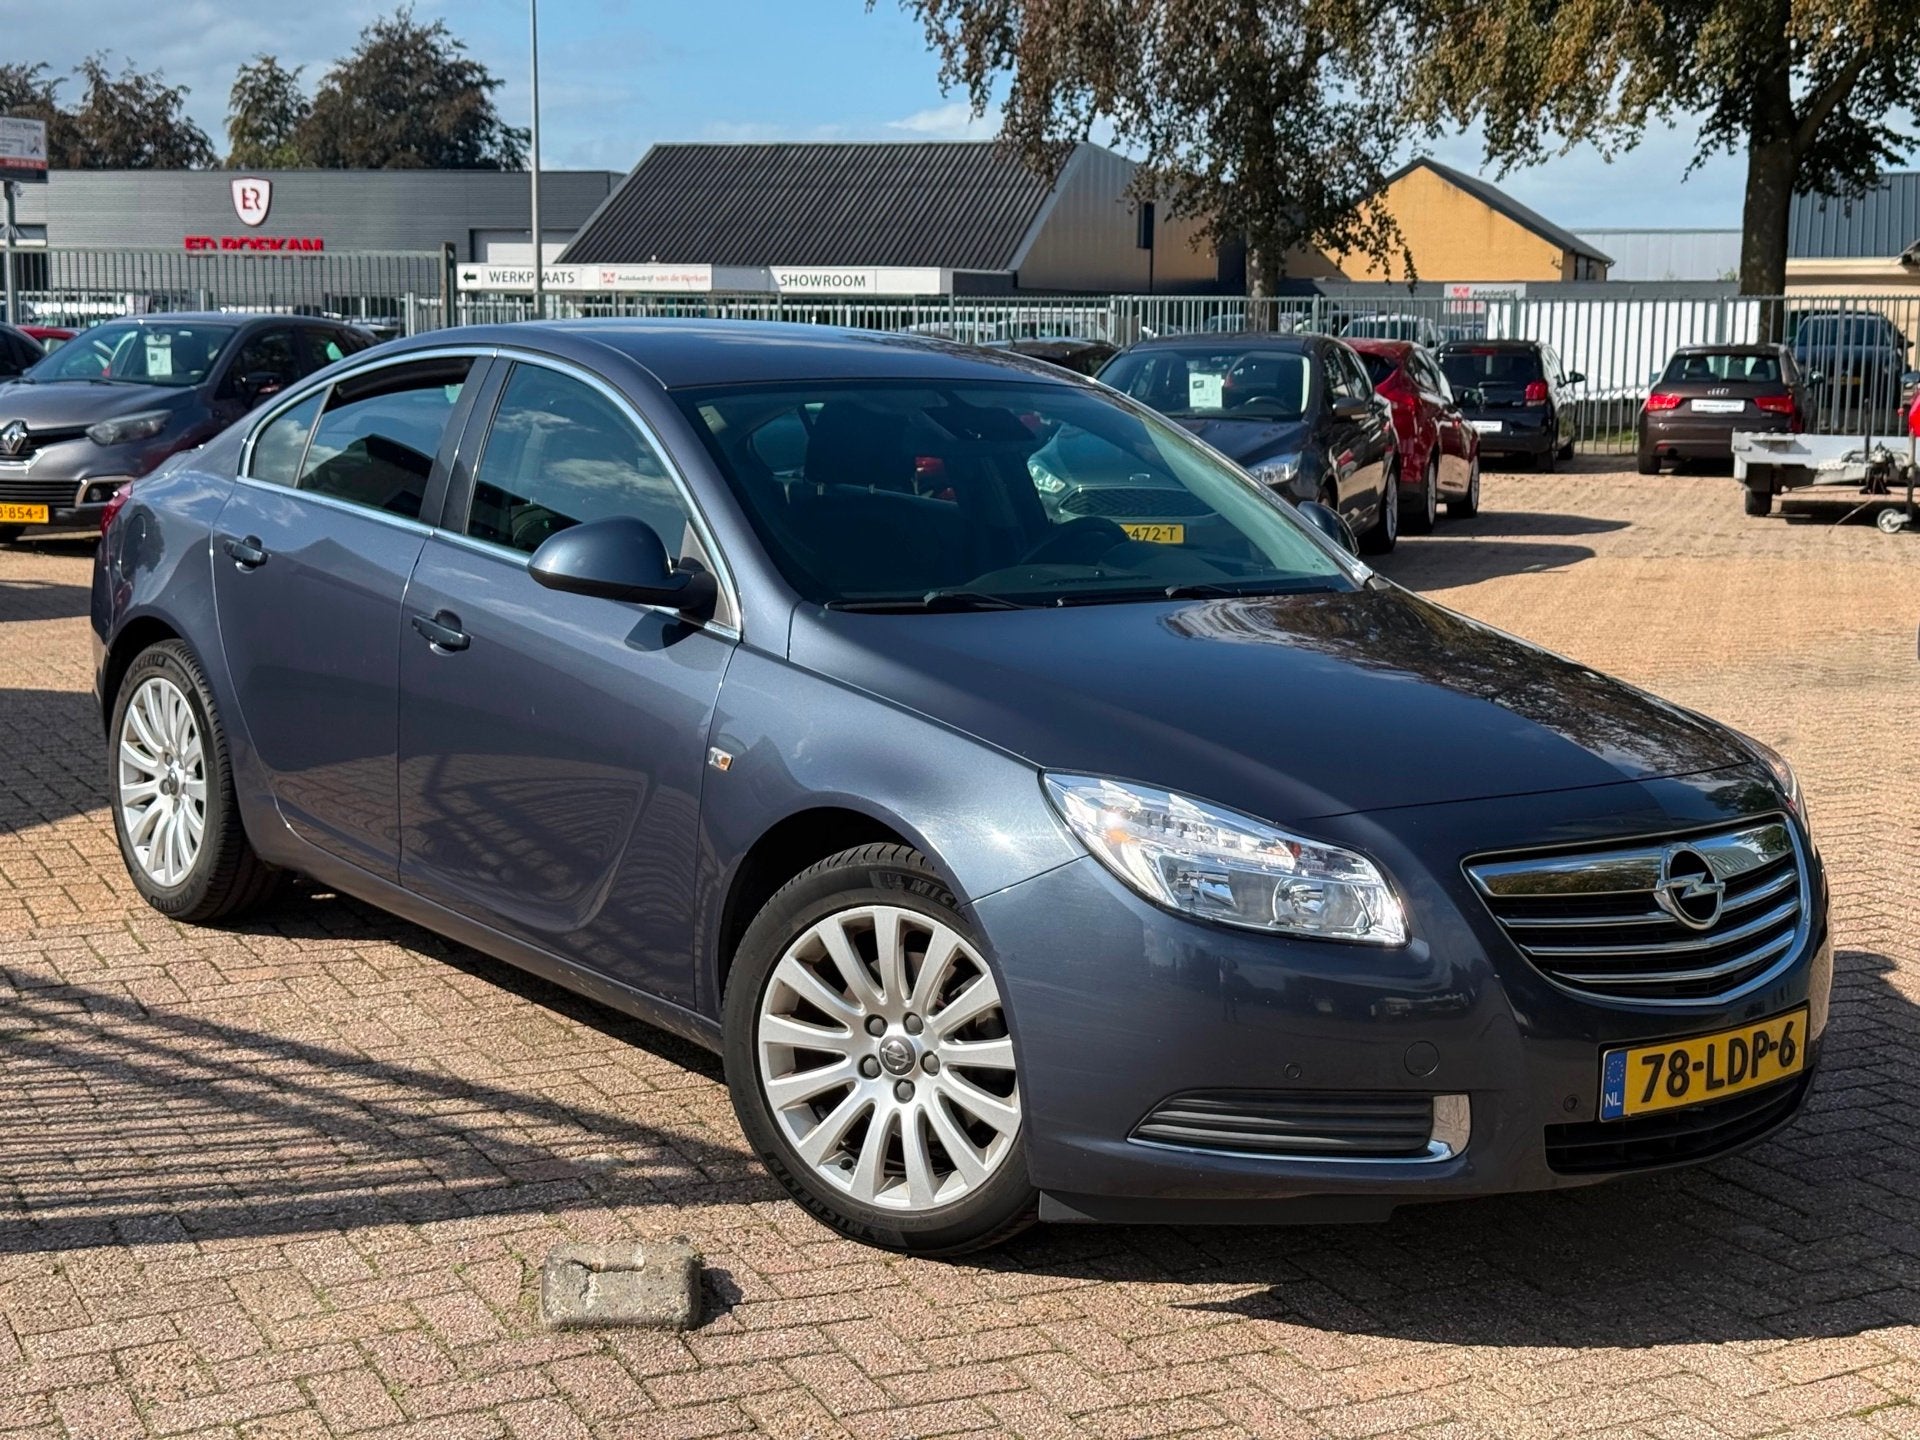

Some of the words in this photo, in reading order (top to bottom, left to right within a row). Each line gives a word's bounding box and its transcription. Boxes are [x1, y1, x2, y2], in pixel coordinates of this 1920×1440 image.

[488, 270, 576, 284] WERKPAATS
[780, 274, 866, 287] SHOWROOM
[1641, 1021, 1797, 1104] 78-LDP-6
[1605, 1091, 1622, 1108] NL
